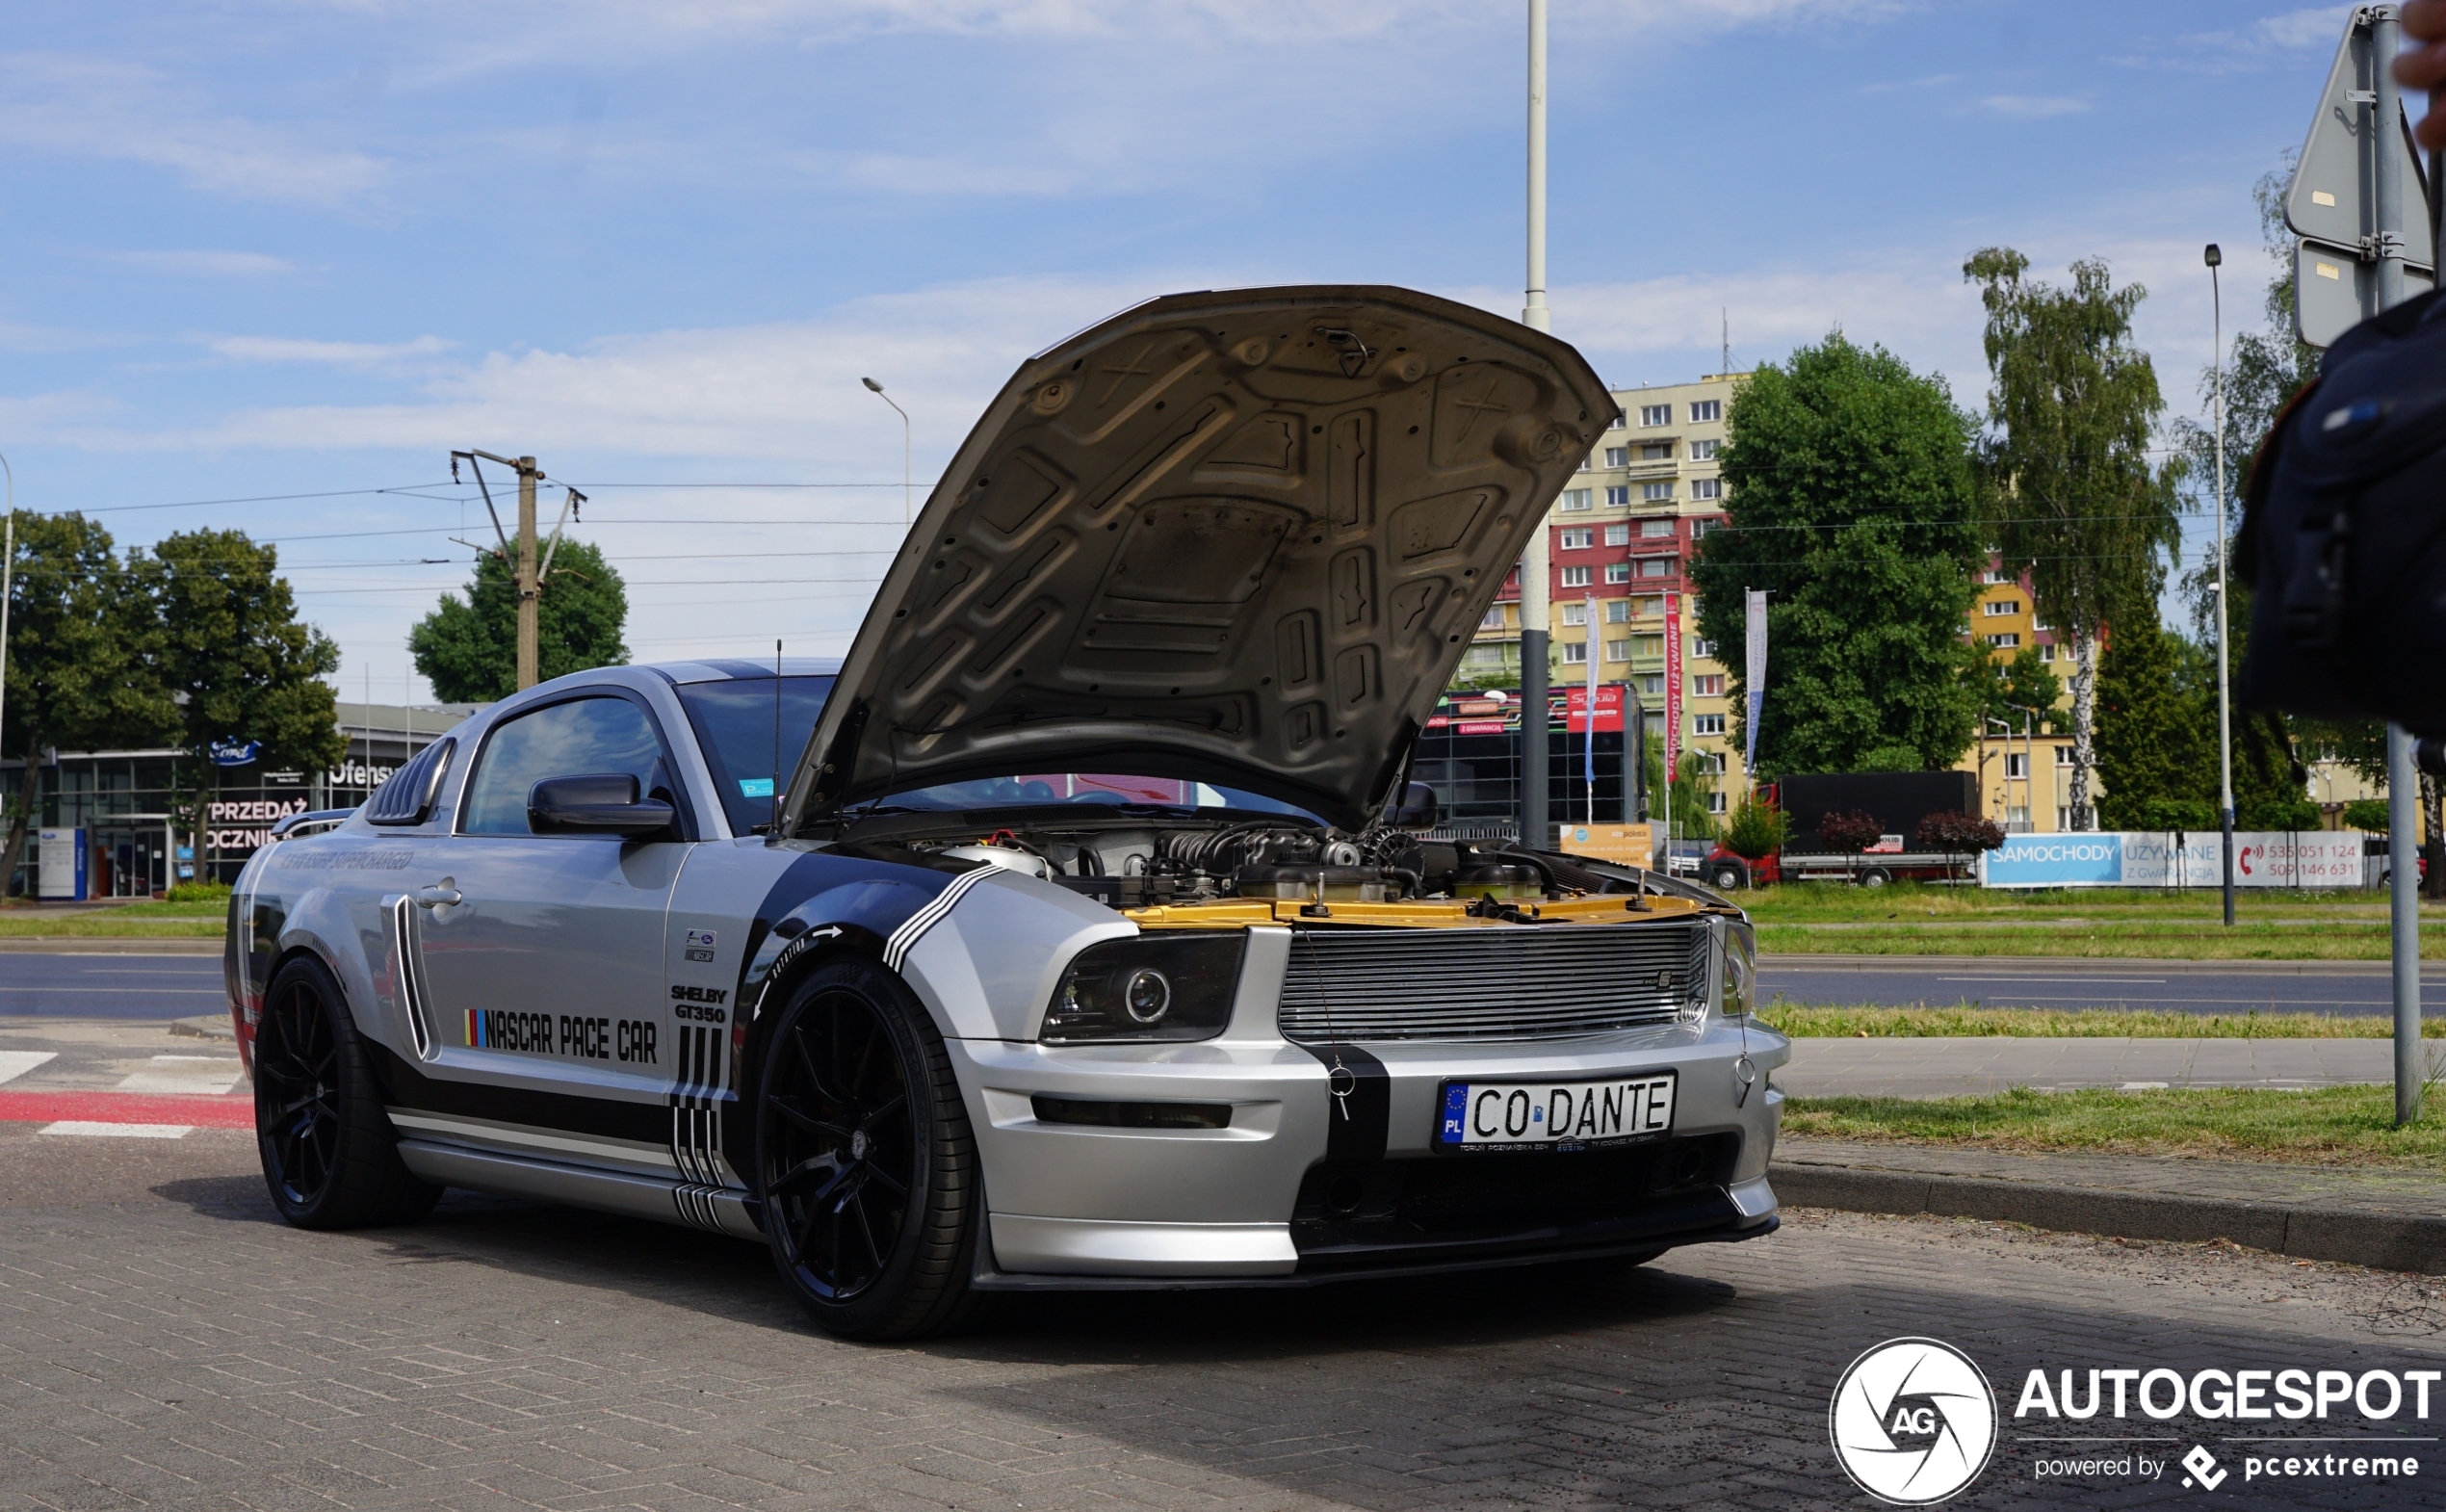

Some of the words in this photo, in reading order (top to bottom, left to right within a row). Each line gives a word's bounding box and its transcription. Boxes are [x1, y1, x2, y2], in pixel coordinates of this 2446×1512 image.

[330, 759, 398, 785] Ofensy
[330, 851, 414, 871] SUPERCHARGED
[1992, 845, 2116, 863] SAMOCHODY
[2126, 842, 2216, 861] UŻYWANE
[2269, 846, 2295, 858] 535
[2300, 846, 2324, 858] 051
[2330, 846, 2355, 857] 124
[2127, 868, 2135, 877] Z
[2140, 868, 2214, 880] GWARANCJĄ
[2269, 864, 2295, 876] 509
[2301, 864, 2325, 875] 146
[2330, 863, 2355, 875] 631
[693, 951, 713, 962] NASCAR
[772, 937, 805, 979] ROTATION
[671, 985, 728, 1004] SHELBY
[675, 1004, 726, 1023] GT350
[484, 1009, 554, 1054] NASCAR
[560, 1015, 610, 1059] PACE
[617, 1020, 658, 1064] CAR
[1548, 1082, 1667, 1136] DANTE
[1444, 1120, 1461, 1134] PL
[1460, 1143, 1485, 1152] TORUŃ
